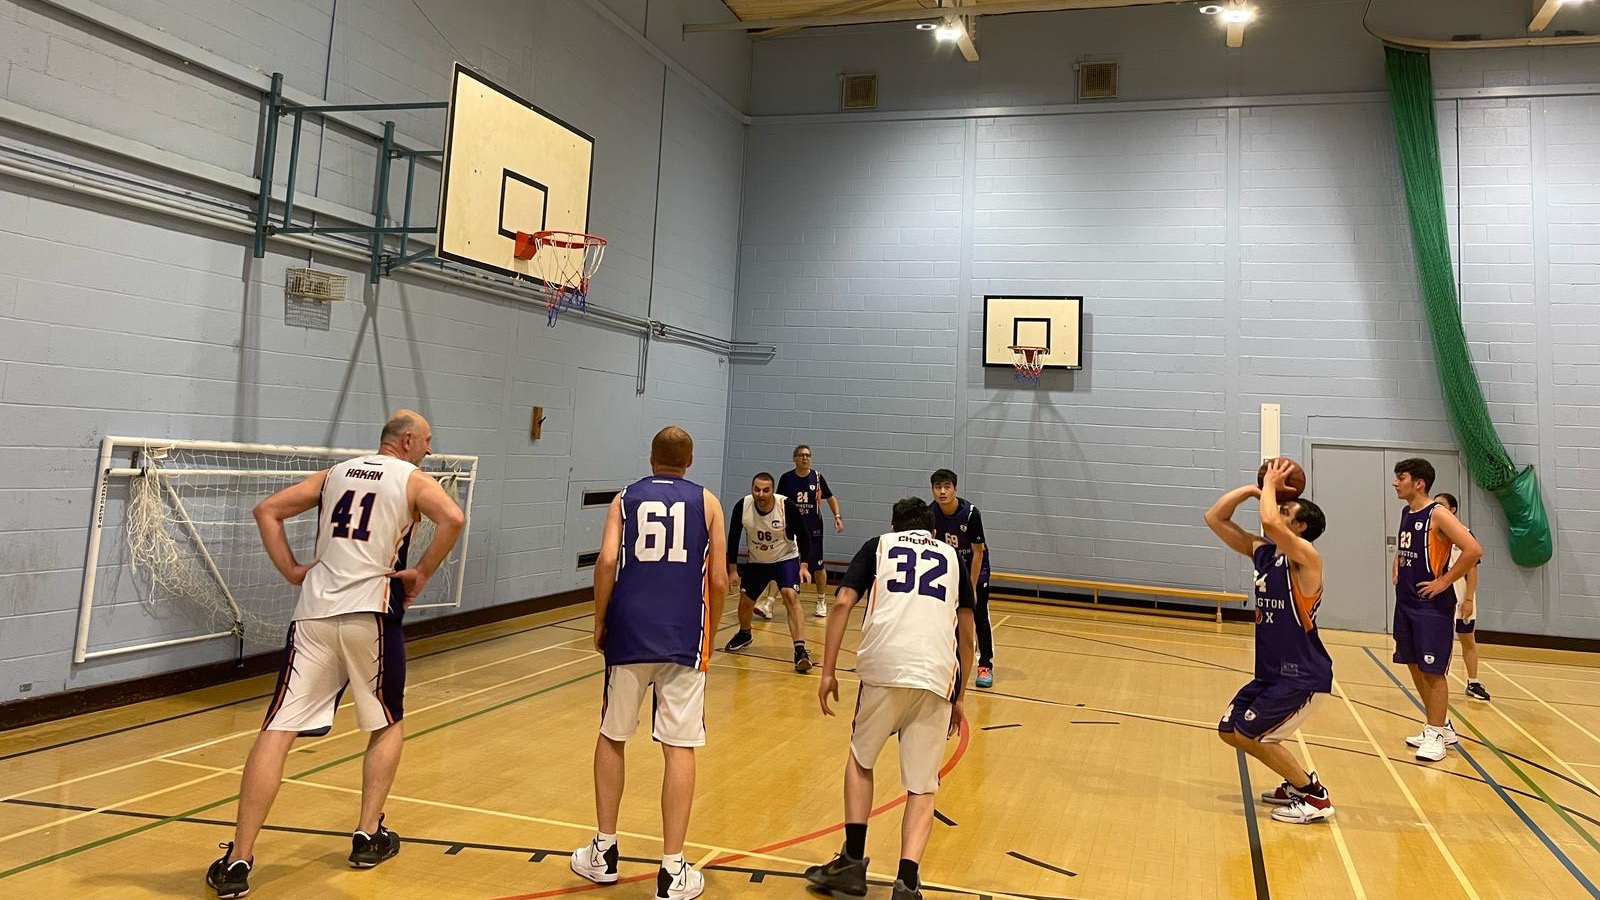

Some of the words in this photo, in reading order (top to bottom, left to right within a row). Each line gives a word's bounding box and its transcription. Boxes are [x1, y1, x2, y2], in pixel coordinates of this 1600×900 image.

[345, 468, 384, 480] HAKAN
[797, 491, 809, 503] 24
[330, 489, 377, 541] 41
[634, 500, 688, 563] 61
[757, 530, 773, 541] 06
[945, 532, 959, 548] 69
[1400, 531, 1412, 549] 23
[887, 546, 948, 602] 32
